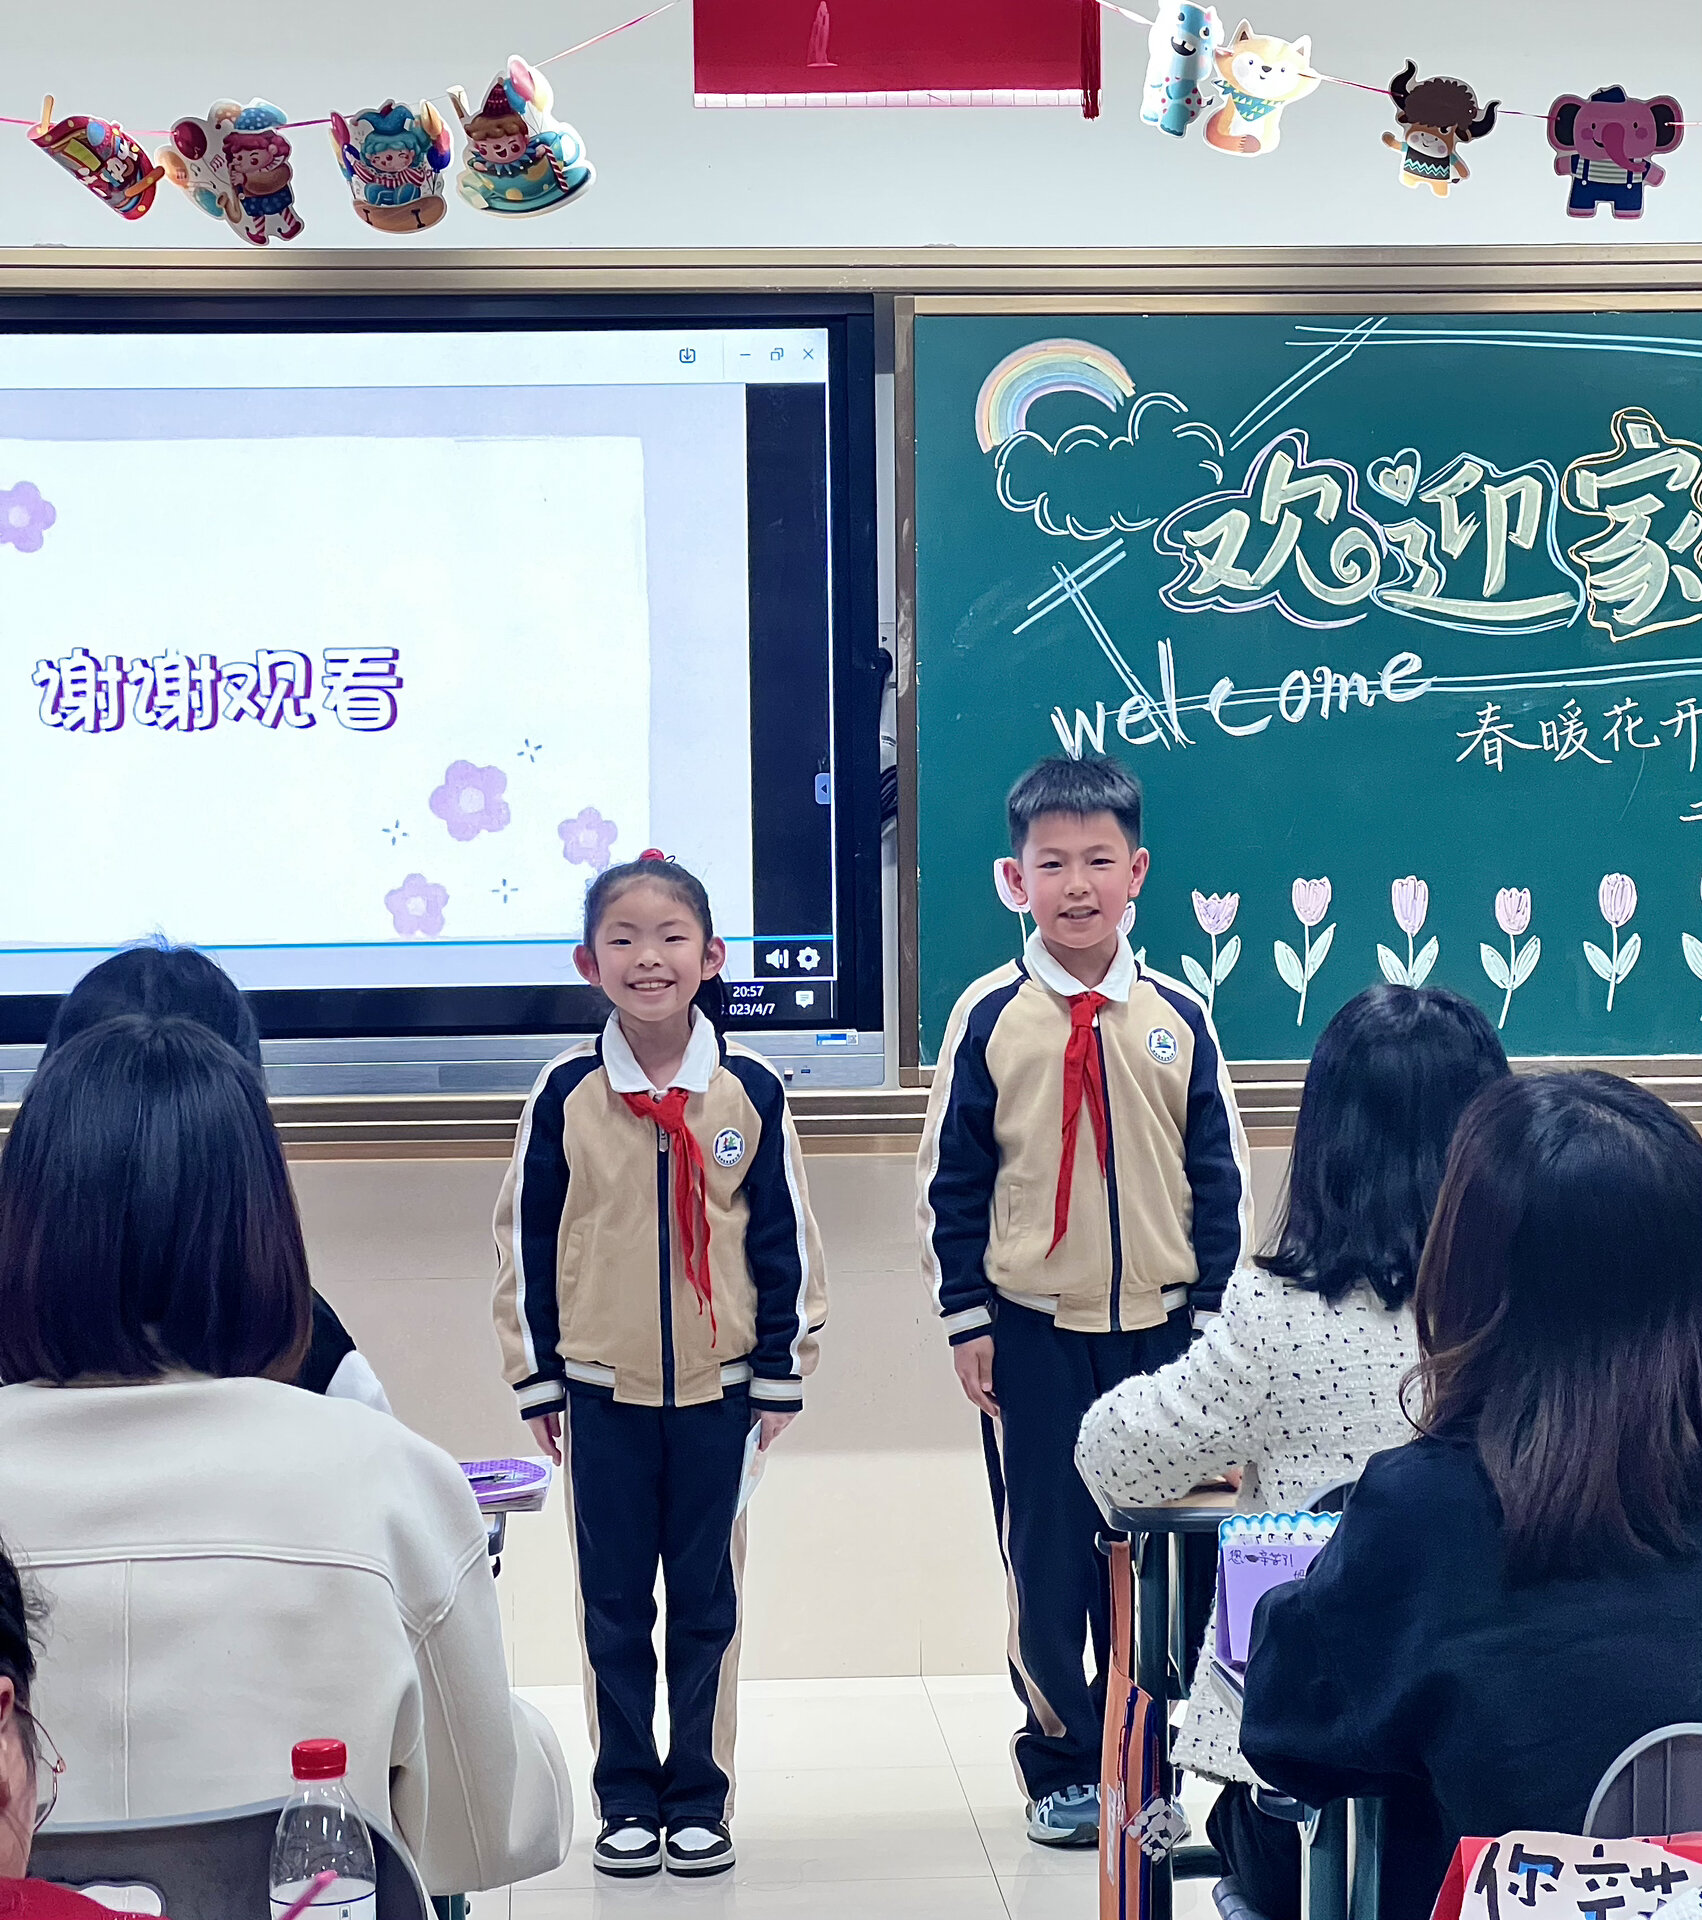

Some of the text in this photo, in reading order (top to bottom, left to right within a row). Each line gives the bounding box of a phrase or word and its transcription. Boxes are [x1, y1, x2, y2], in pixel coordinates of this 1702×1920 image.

[31, 646, 404, 733] 谢谢观看
[1050, 637, 1438, 761] welcome
[1455, 697, 1702, 773] 春暖花开
[721, 1002, 776, 1016] 023/4/7
[732, 985, 765, 998] 20:57
